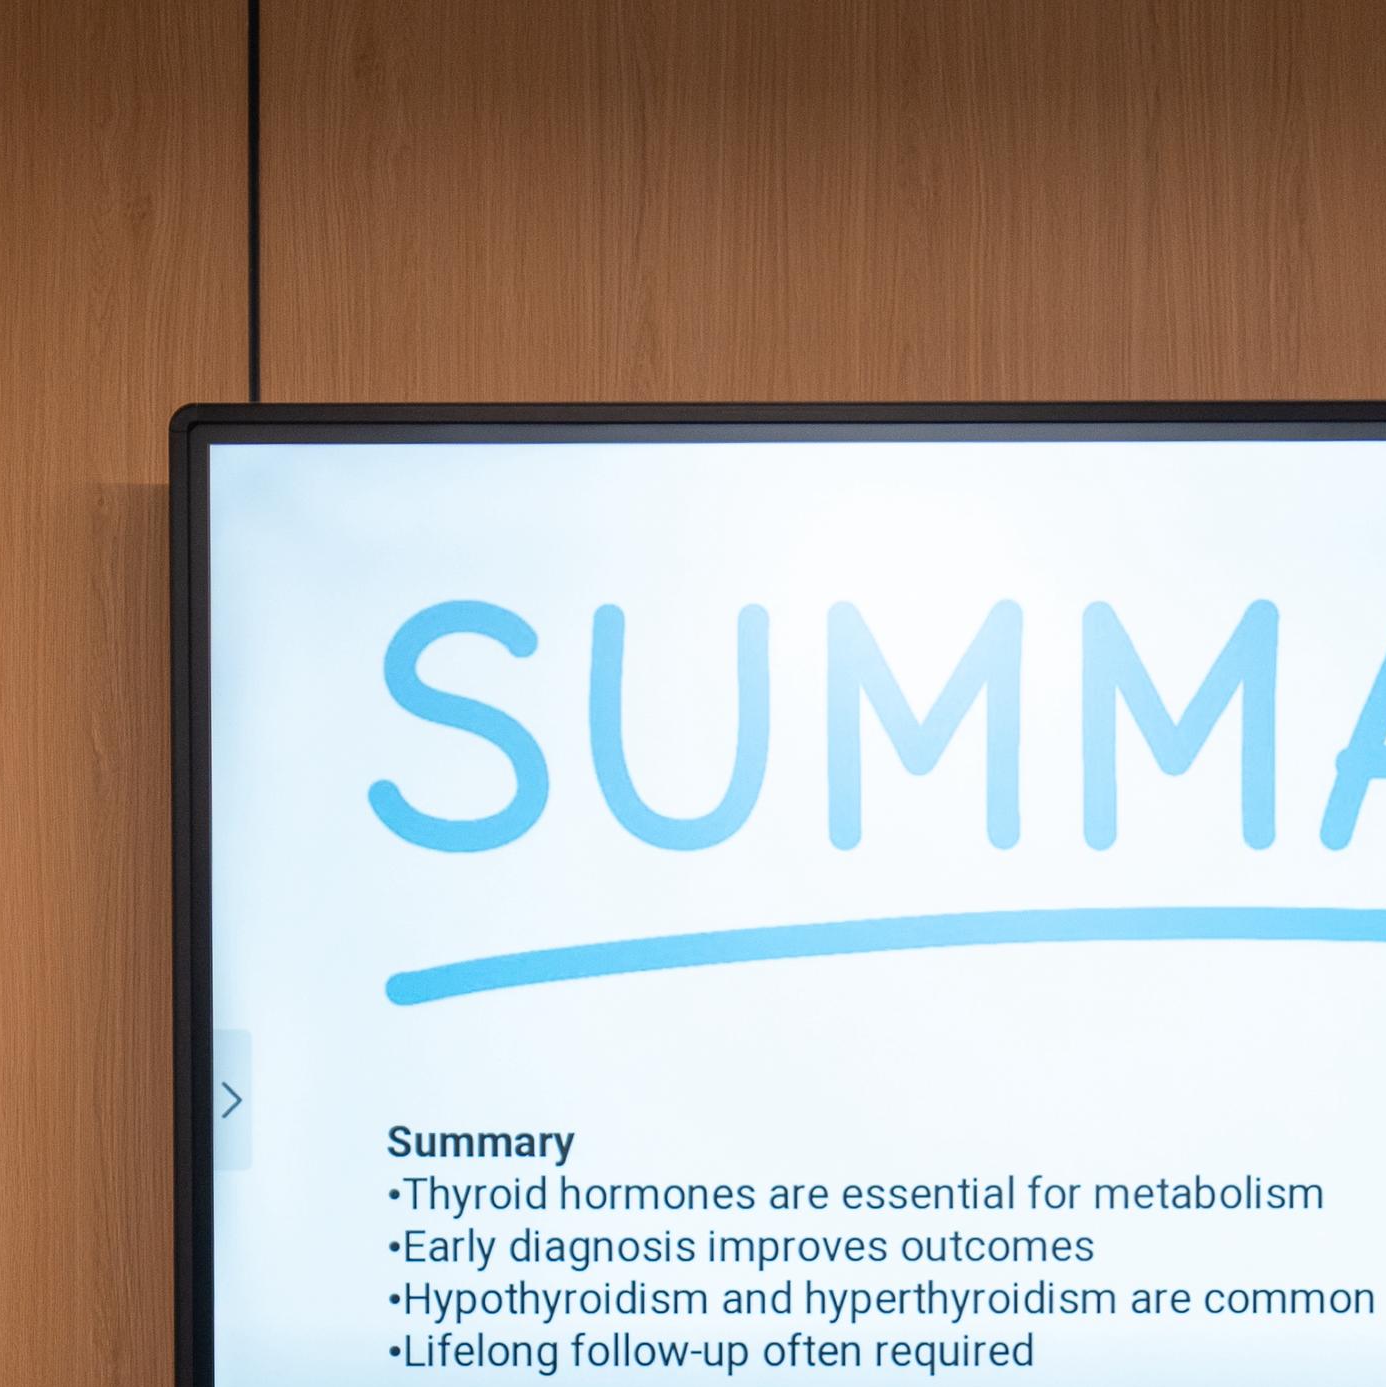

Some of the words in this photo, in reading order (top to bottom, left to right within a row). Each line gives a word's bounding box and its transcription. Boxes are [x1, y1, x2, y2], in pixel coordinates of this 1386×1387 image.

[388, 1126, 575, 1167] Summary
[561, 1175, 755, 1209] hormones
[770, 1185, 828, 1209] are
[843, 1175, 1013, 1209] essential
[1028, 1175, 1081, 1209] for
[1096, 1175, 1322, 1209] metabolism
[510, 1228, 695, 1272] diagnosis
[710, 1230, 887, 1271] improves
[902, 1231, 1093, 1261] outcomes
[723, 1280, 791, 1314] and
[807, 1280, 1115, 1324] hyperthyroidism
[1132, 1290, 1191, 1314] are
[1205, 1289, 1373, 1314] common
[571, 1332, 748, 1376] follow-up
[764, 1332, 860, 1366] often
[877, 1332, 1033, 1376] required
